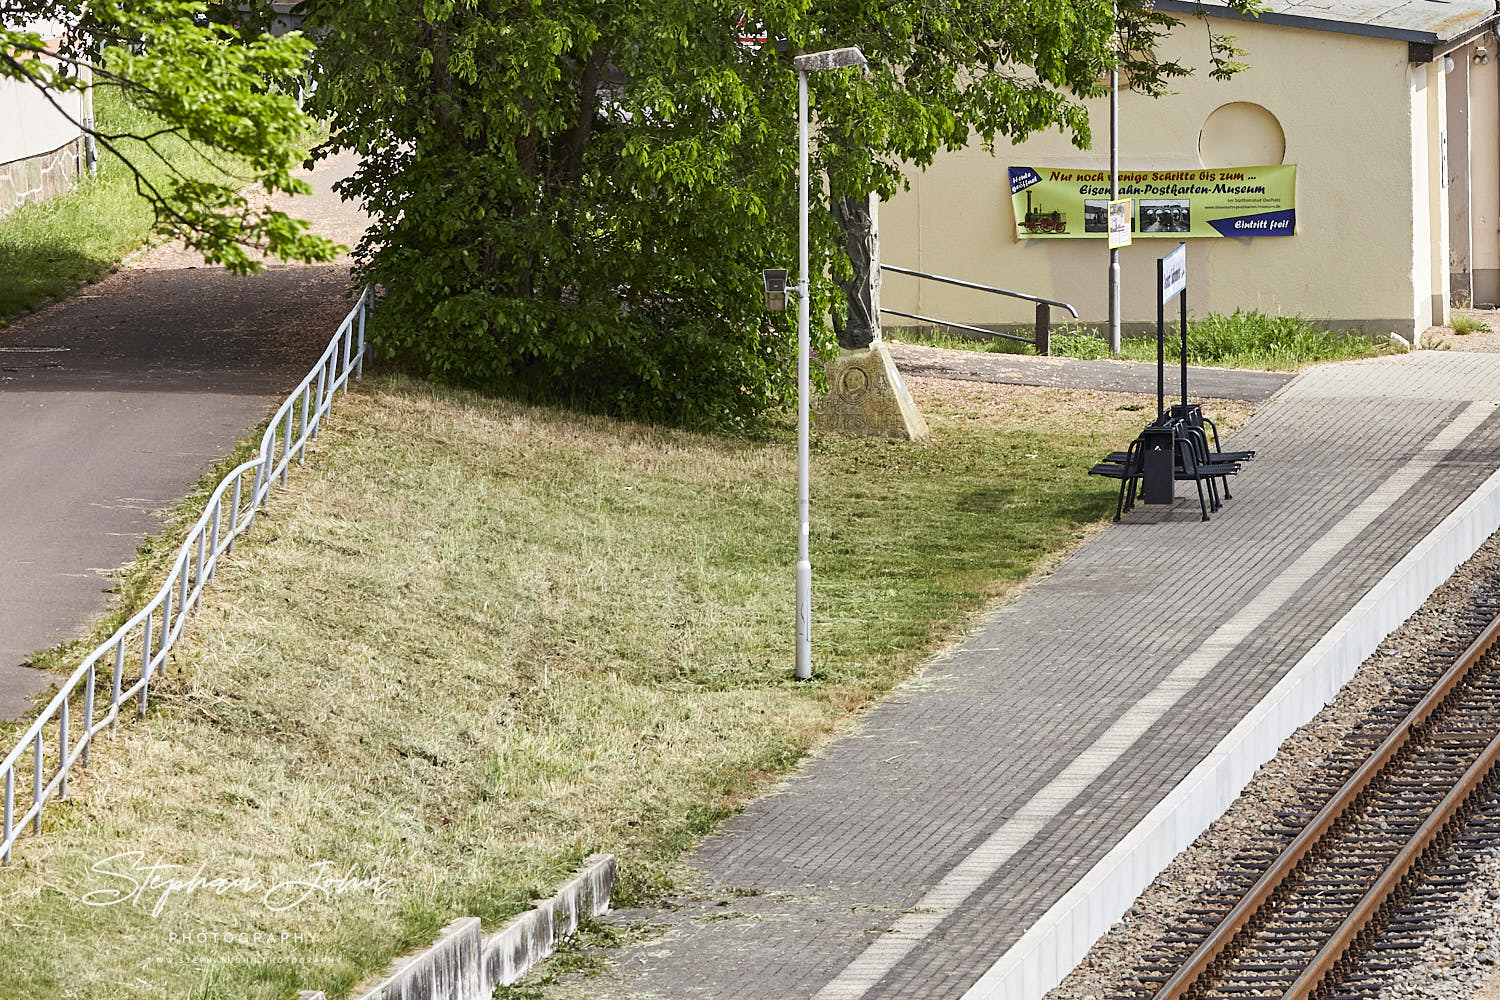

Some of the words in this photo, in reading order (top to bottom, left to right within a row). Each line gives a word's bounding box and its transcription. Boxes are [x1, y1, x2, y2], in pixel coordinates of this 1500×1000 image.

[1049, 171, 1073, 182] Nur
[1077, 171, 1104, 182] noch
[1108, 172, 1148, 184] enige
[1151, 171, 1196, 182] Schritte
[1199, 171, 1216, 182] bis
[1219, 172, 1244, 182] zum
[1079, 183, 1265, 197] Eisenahn-Postkarten-Museum
[1234, 220, 1268, 230] Eintritt
[1269, 219, 1289, 230] frei!
